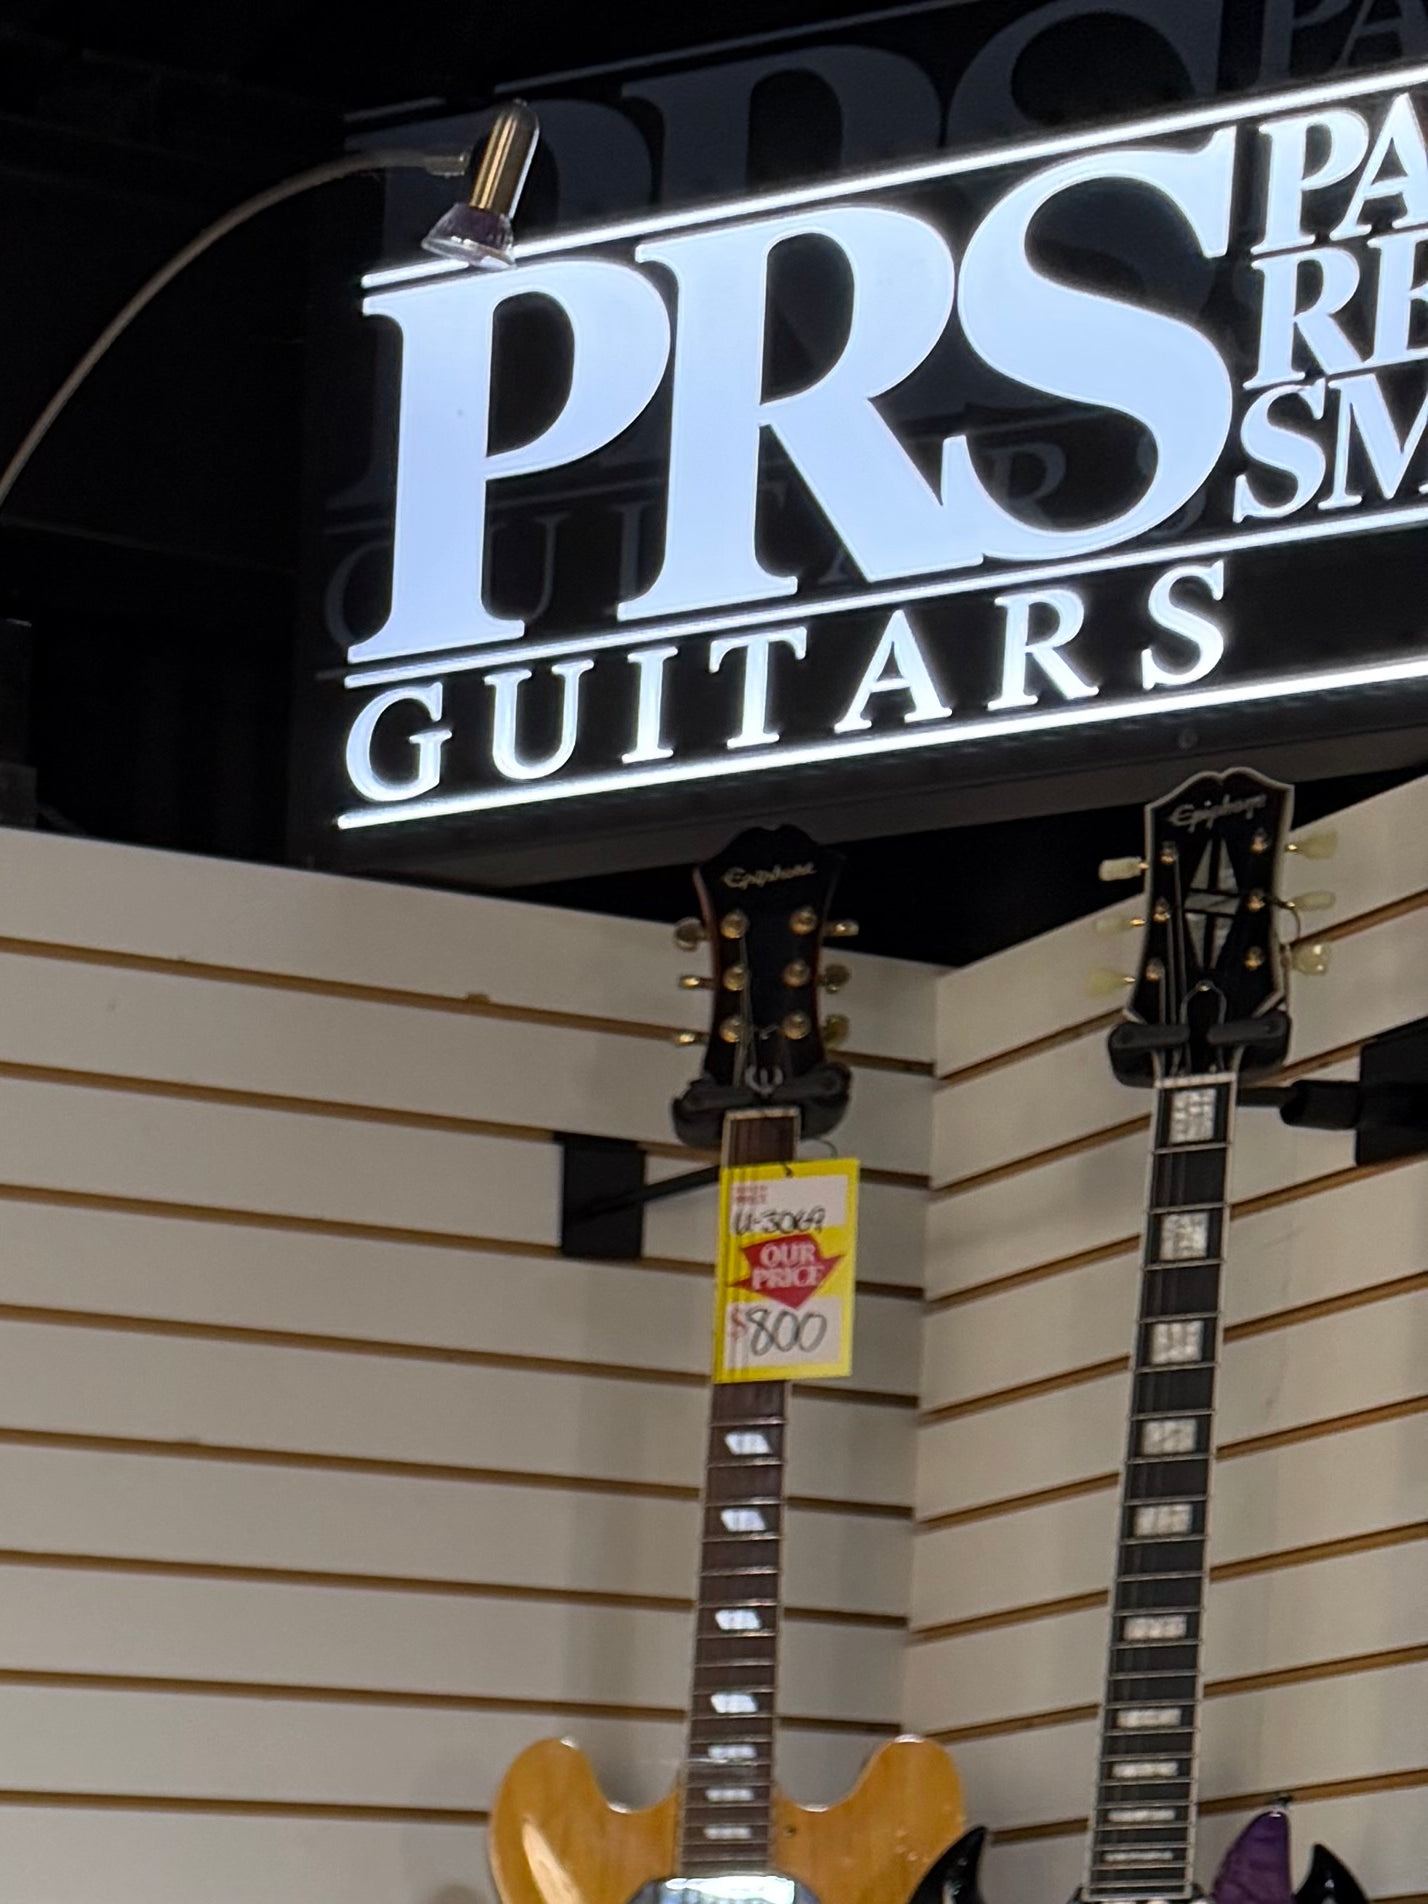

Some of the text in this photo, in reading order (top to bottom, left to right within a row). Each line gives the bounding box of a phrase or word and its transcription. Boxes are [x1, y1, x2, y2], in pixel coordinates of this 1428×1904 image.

[347, 127, 1237, 664] PRS
[345, 559, 1227, 804] GUITARS
[751, 1264, 827, 1291] PRICE
[759, 1241, 818, 1267] OUR
